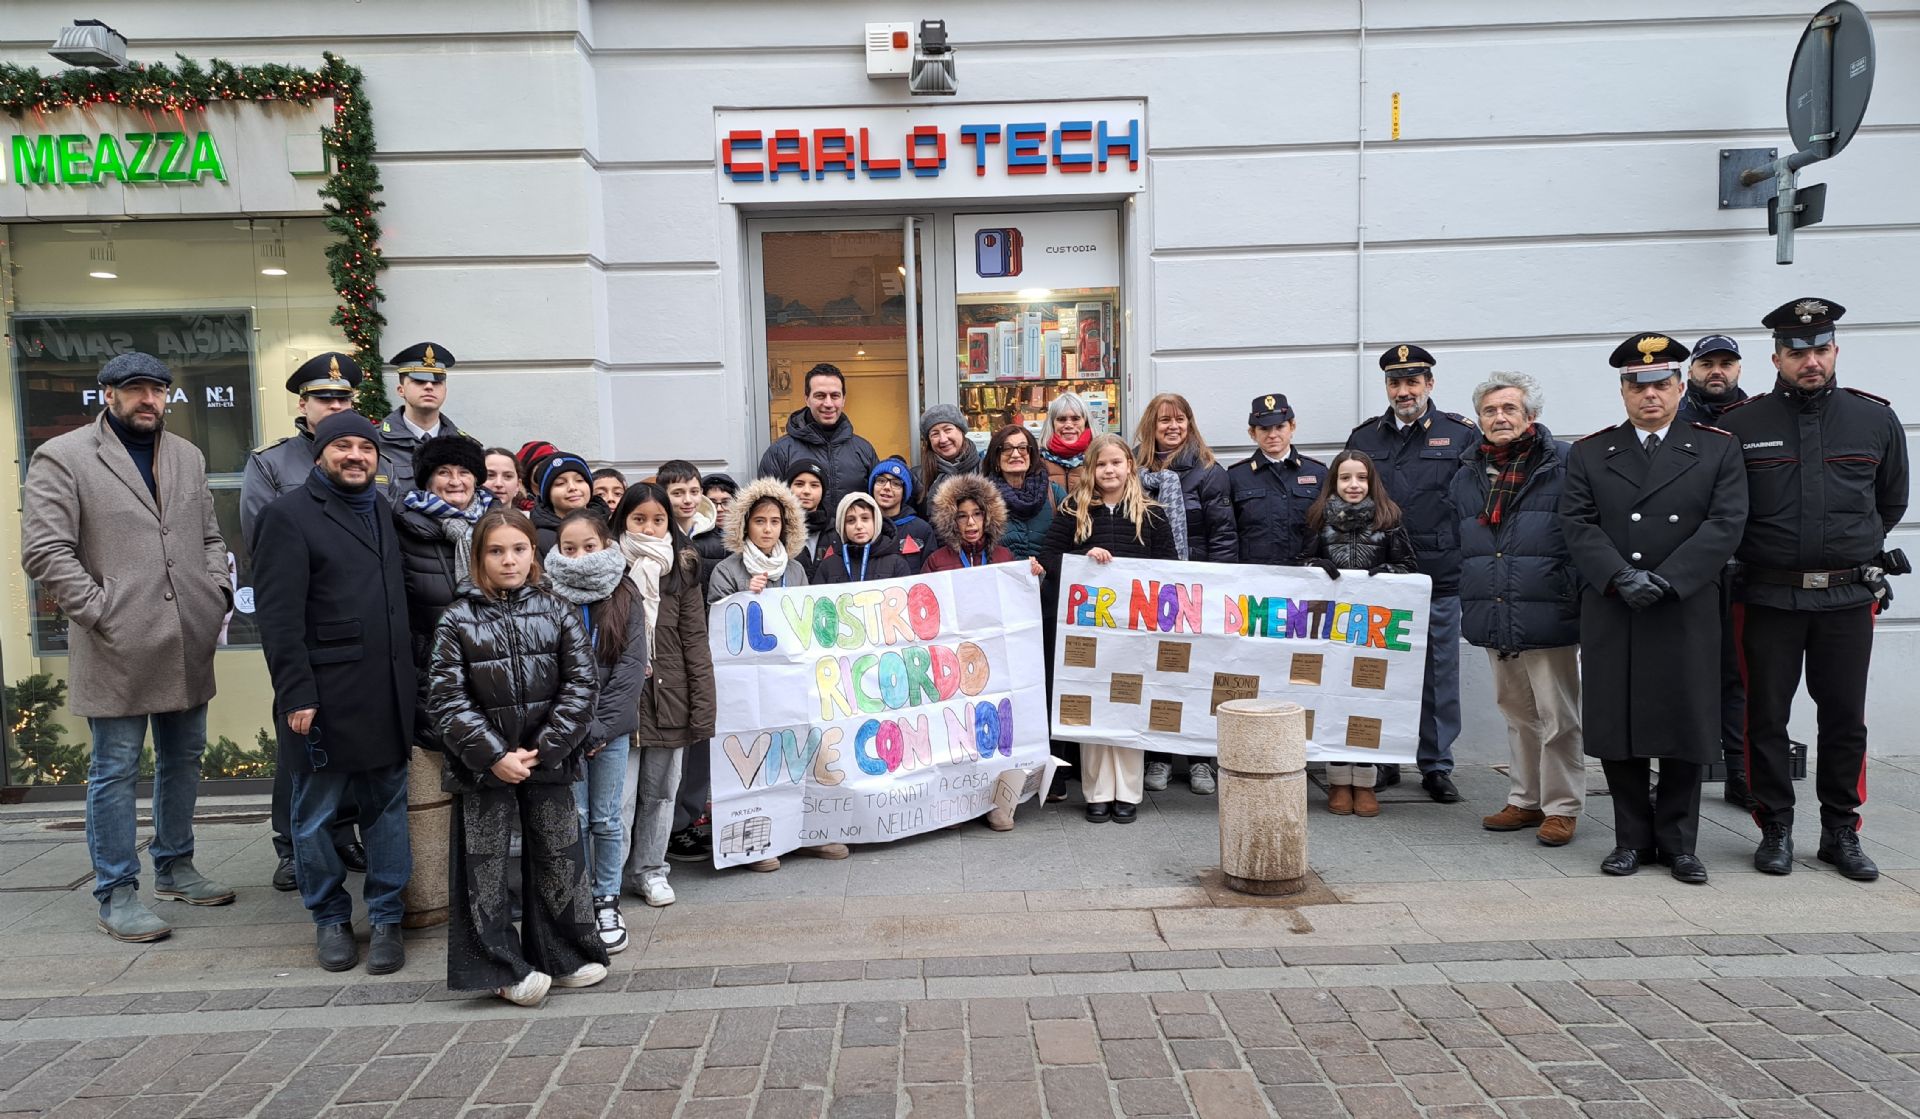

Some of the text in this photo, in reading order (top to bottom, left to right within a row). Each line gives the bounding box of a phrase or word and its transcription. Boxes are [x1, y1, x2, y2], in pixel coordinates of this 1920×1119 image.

[11, 131, 228, 185] MEAZZA
[722, 119, 1138, 181] CARLO TECH
[1046, 244, 1097, 254] CUSTODIA
[1743, 440, 1784, 450] CARABINIERI
[725, 582, 940, 656] IL VOSTRO
[1066, 579, 1413, 652] PER NON DIMENTICARE
[815, 642, 990, 721] RICORDO
[1214, 675, 1258, 689] NON SONO
[723, 697, 1013, 790] VIVE CON NOI
[798, 788, 991, 840] CON NOI NELLA MEMORIA
[801, 796, 854, 814] SIETE
[864, 783, 929, 809] TORNATI
[939, 777, 948, 793] A
